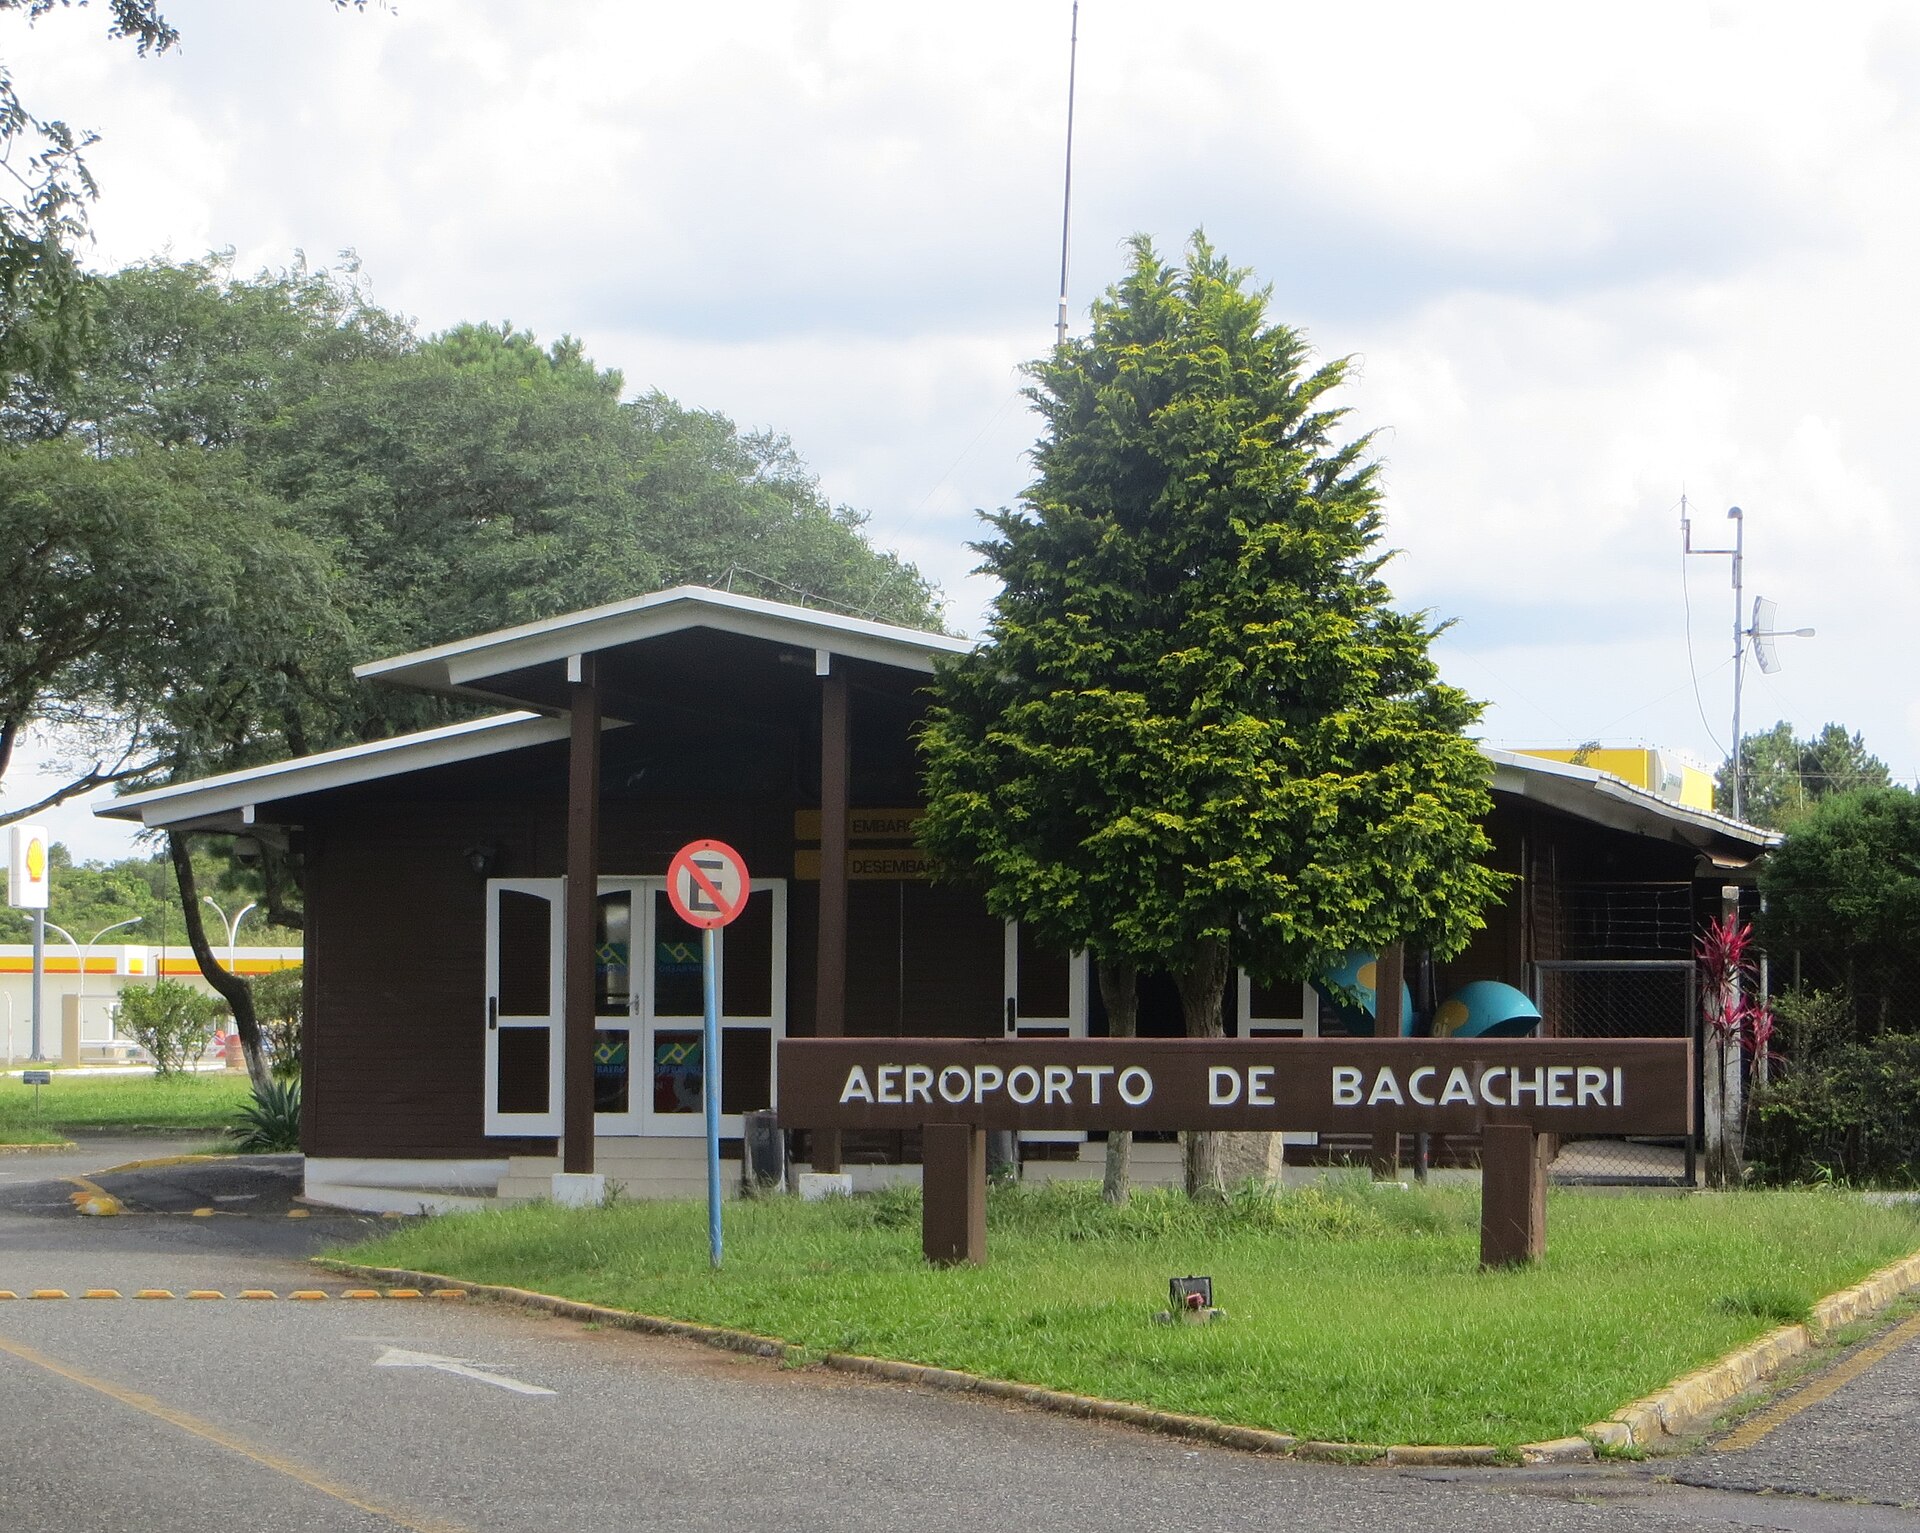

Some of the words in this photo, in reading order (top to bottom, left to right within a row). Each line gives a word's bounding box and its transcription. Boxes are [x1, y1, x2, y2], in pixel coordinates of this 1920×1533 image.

[689, 859, 723, 912] E
[839, 1064, 1154, 1105] AEROPORTO
[1208, 1066, 1276, 1106] DE
[1332, 1066, 1622, 1107] BACACHERI
